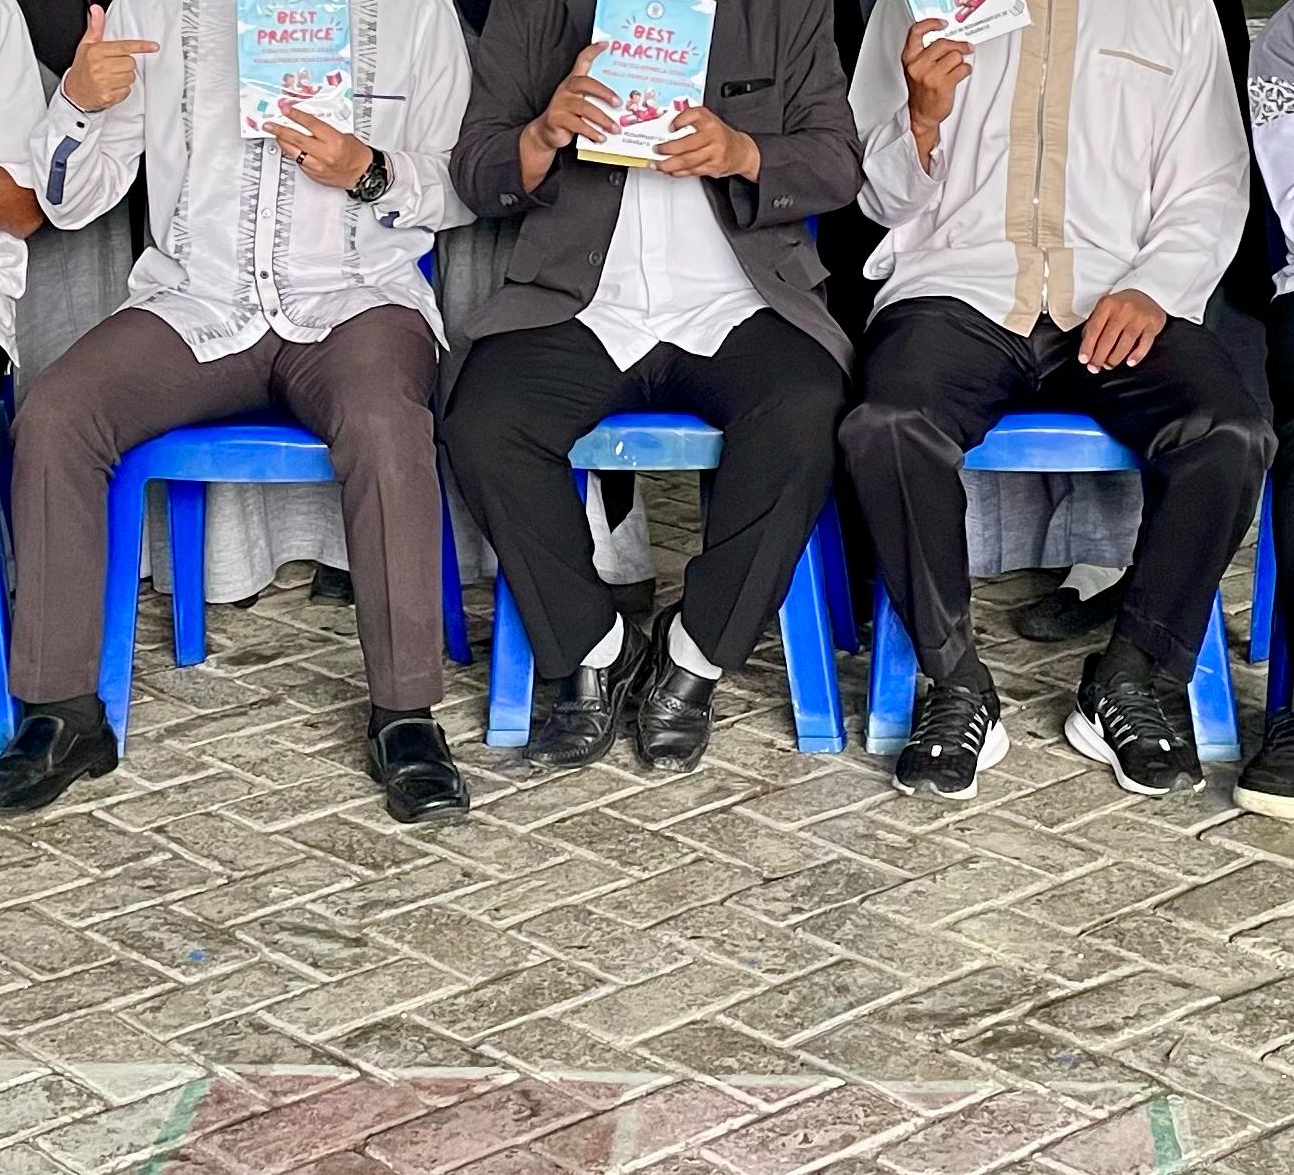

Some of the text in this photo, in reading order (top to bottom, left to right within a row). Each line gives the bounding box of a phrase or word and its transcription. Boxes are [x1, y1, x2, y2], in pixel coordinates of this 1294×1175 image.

[277, 10, 317, 25] BEST
[257, 28, 334, 46] PRACTICE
[633, 24, 675, 44] BEST
[609, 40, 690, 65] PRACTICE
